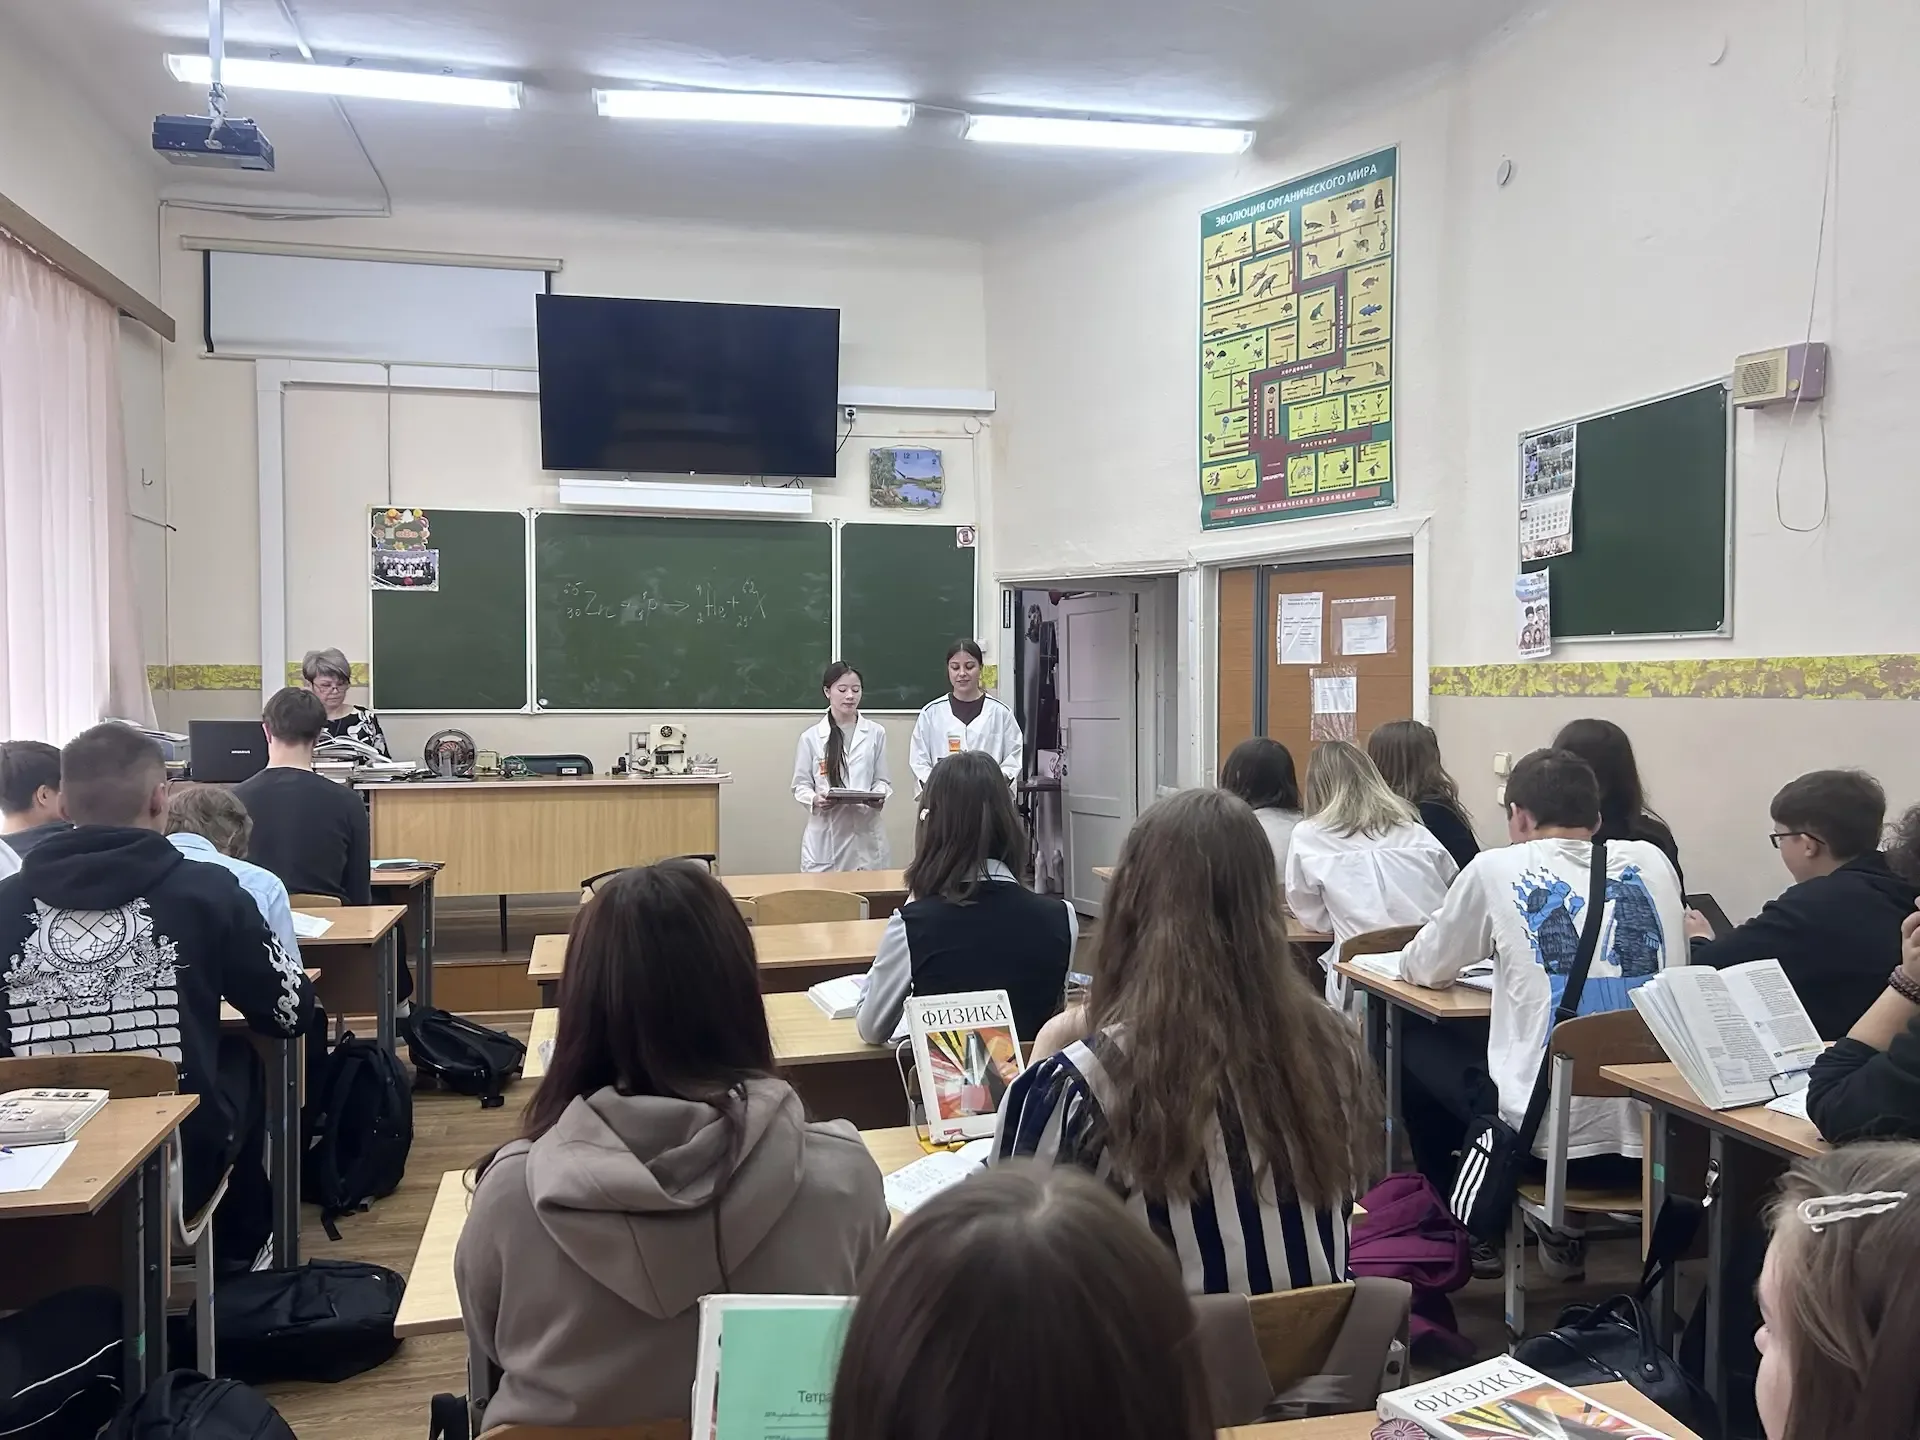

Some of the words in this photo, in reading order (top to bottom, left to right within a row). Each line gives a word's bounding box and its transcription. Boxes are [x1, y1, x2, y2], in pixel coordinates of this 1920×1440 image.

[1215, 202, 1266, 227] ЭВОЛЮЦИЯ
[1267, 174, 1346, 210] ОРГАНИЧЕСКОГО
[1347, 163, 1378, 185] МИРА
[922, 1004, 1007, 1026] ФИЗИКА
[1414, 1368, 1537, 1413] ФИЗИКА
